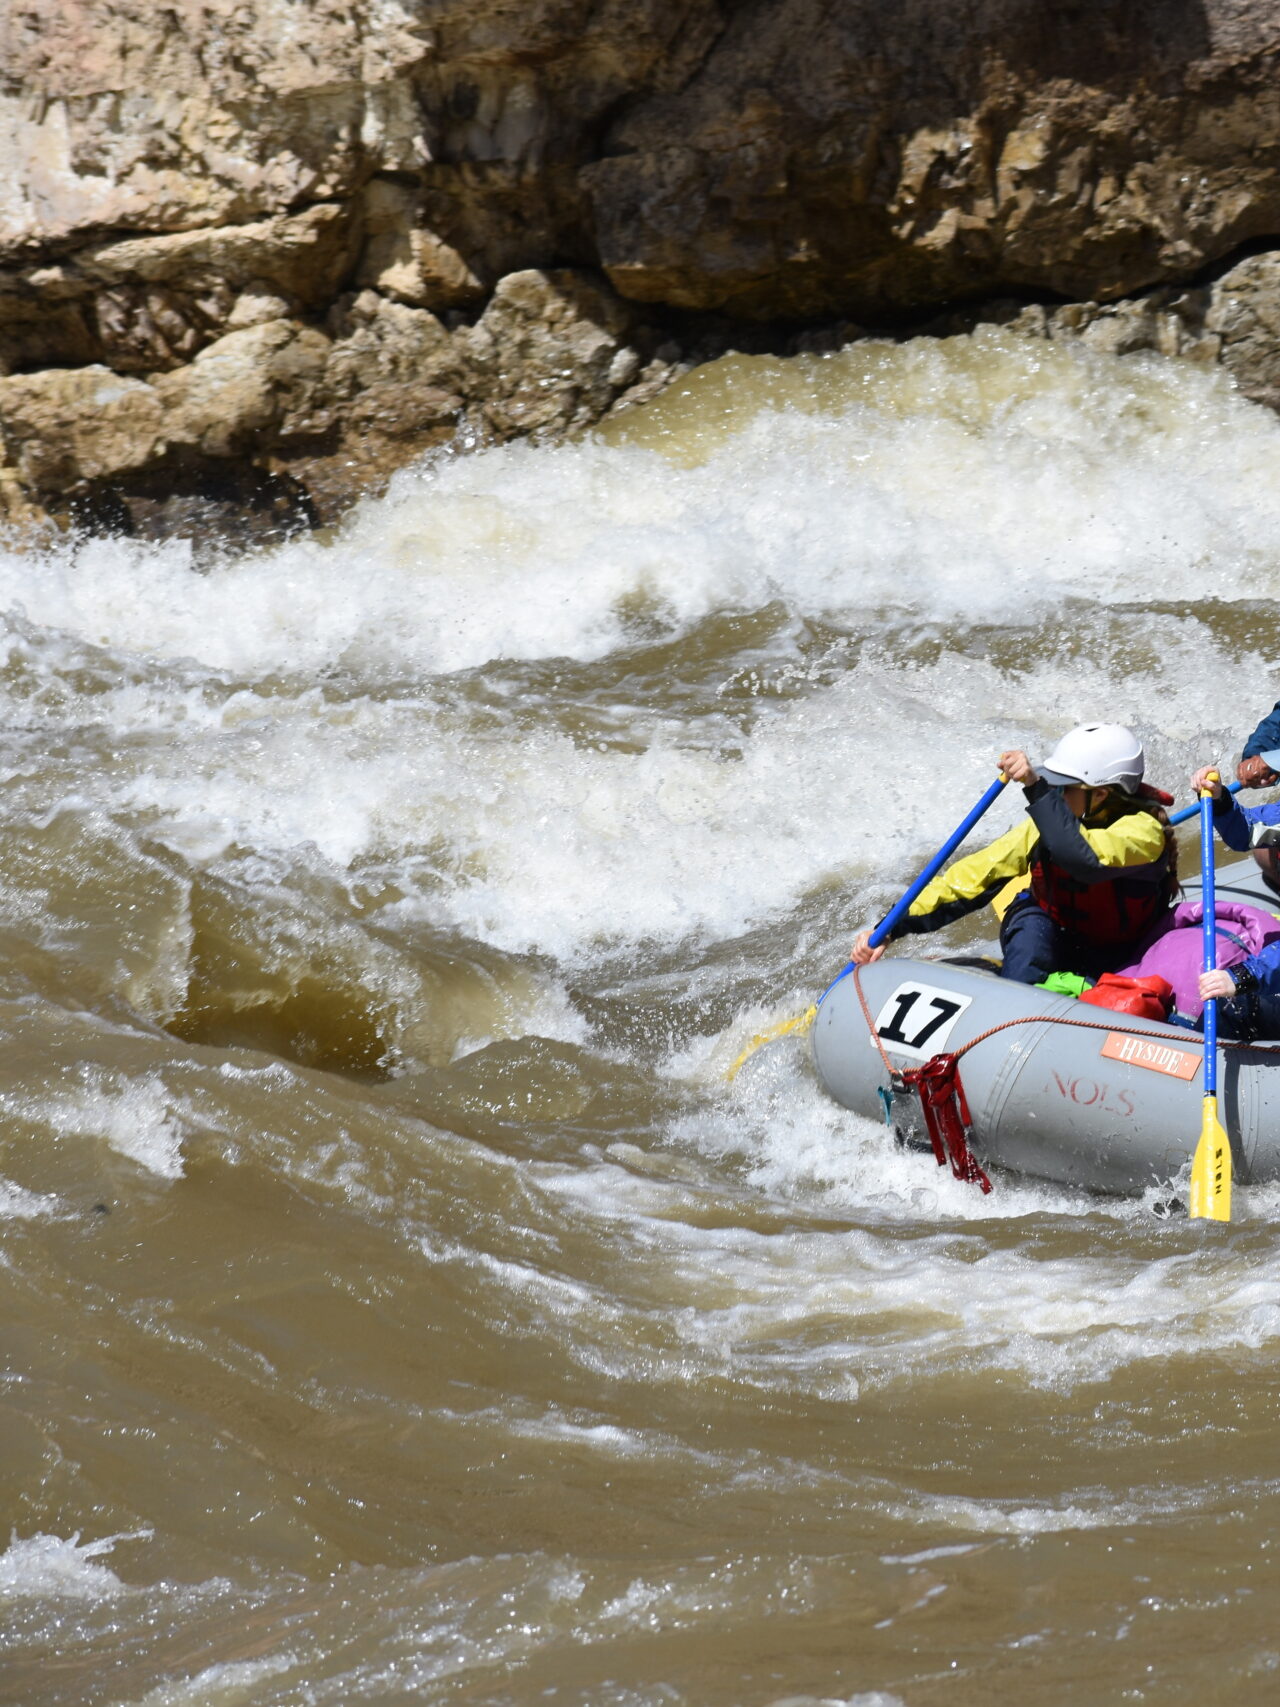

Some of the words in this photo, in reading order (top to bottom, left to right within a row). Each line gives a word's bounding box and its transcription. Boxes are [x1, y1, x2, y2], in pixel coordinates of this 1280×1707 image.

[877, 990, 962, 1049] 17
[1118, 1037, 1185, 1074] HYSIDE
[1044, 1069, 1136, 1117] NOLS
